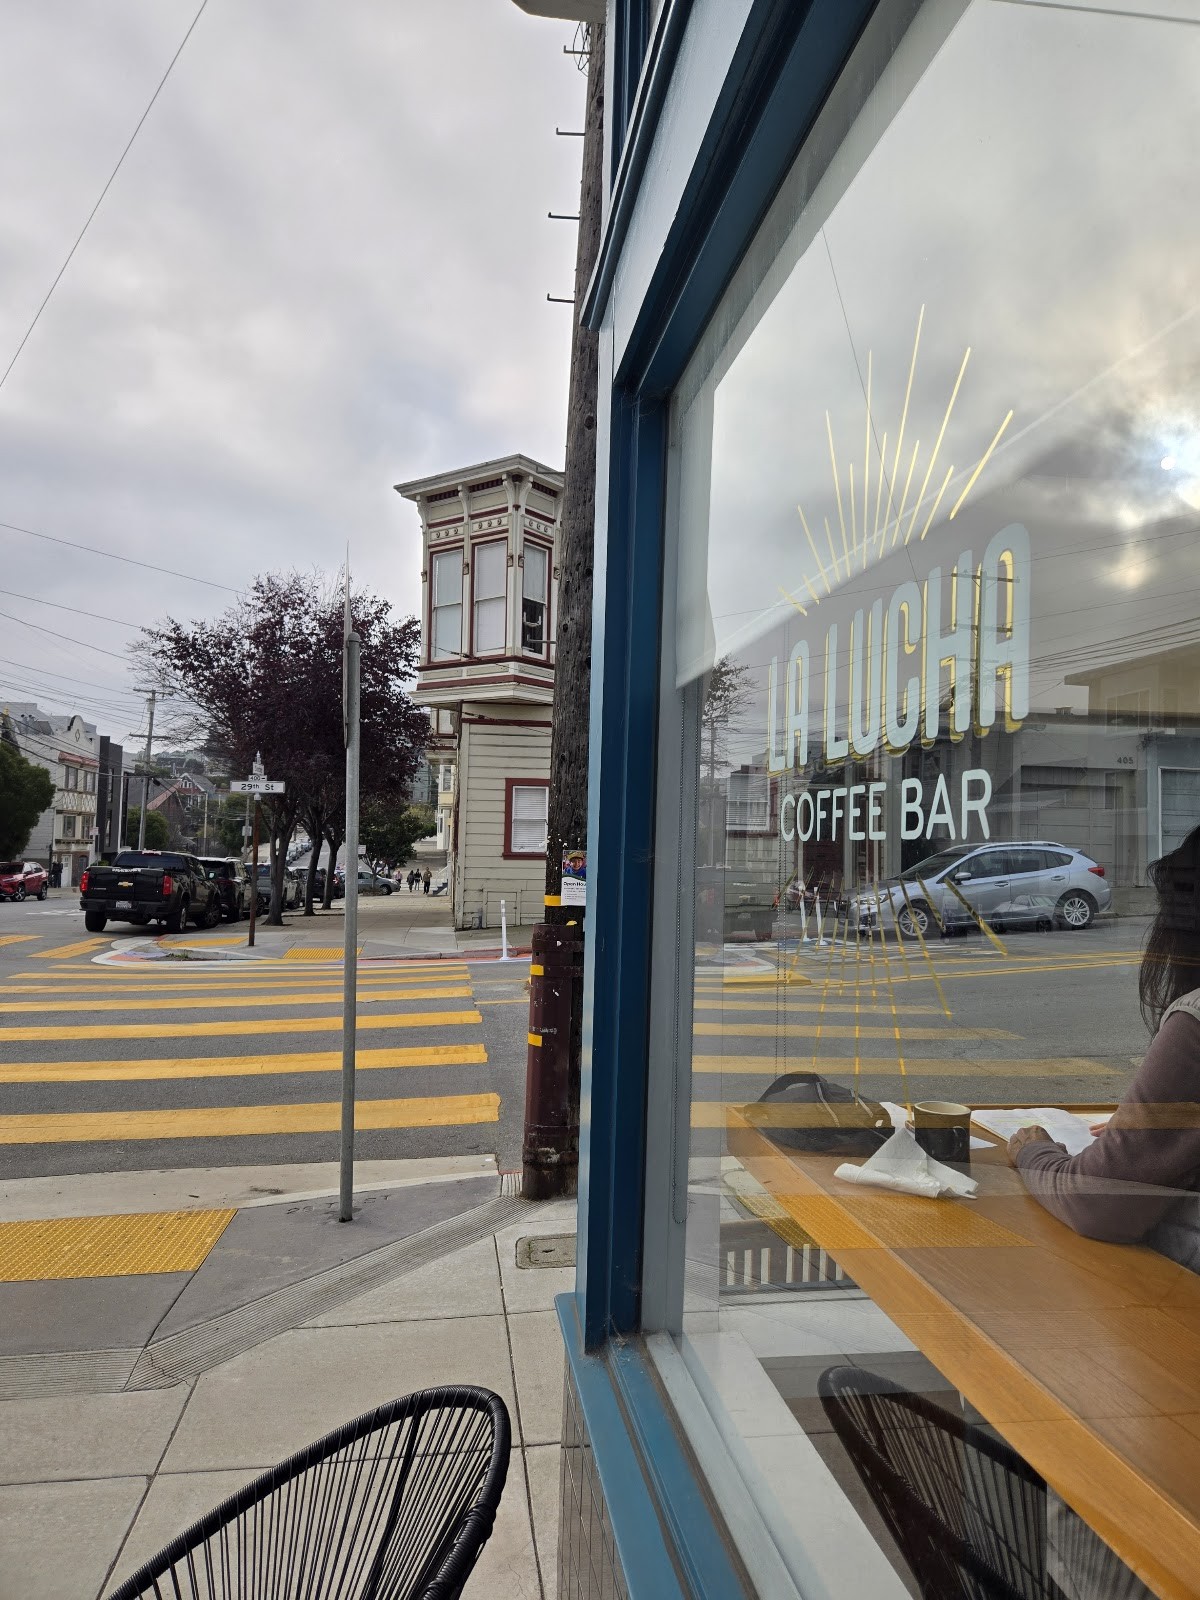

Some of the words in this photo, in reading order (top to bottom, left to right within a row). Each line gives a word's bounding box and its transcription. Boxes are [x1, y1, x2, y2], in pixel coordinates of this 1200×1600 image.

[768, 639, 810, 773] LA
[824, 522, 1031, 762] LUCHA
[1117, 756, 1134, 765] 405
[241, 783, 260, 791] 29th
[264, 783, 275, 791] St
[781, 782, 886, 842] COFFEE
[901, 768, 992, 840] BAR
